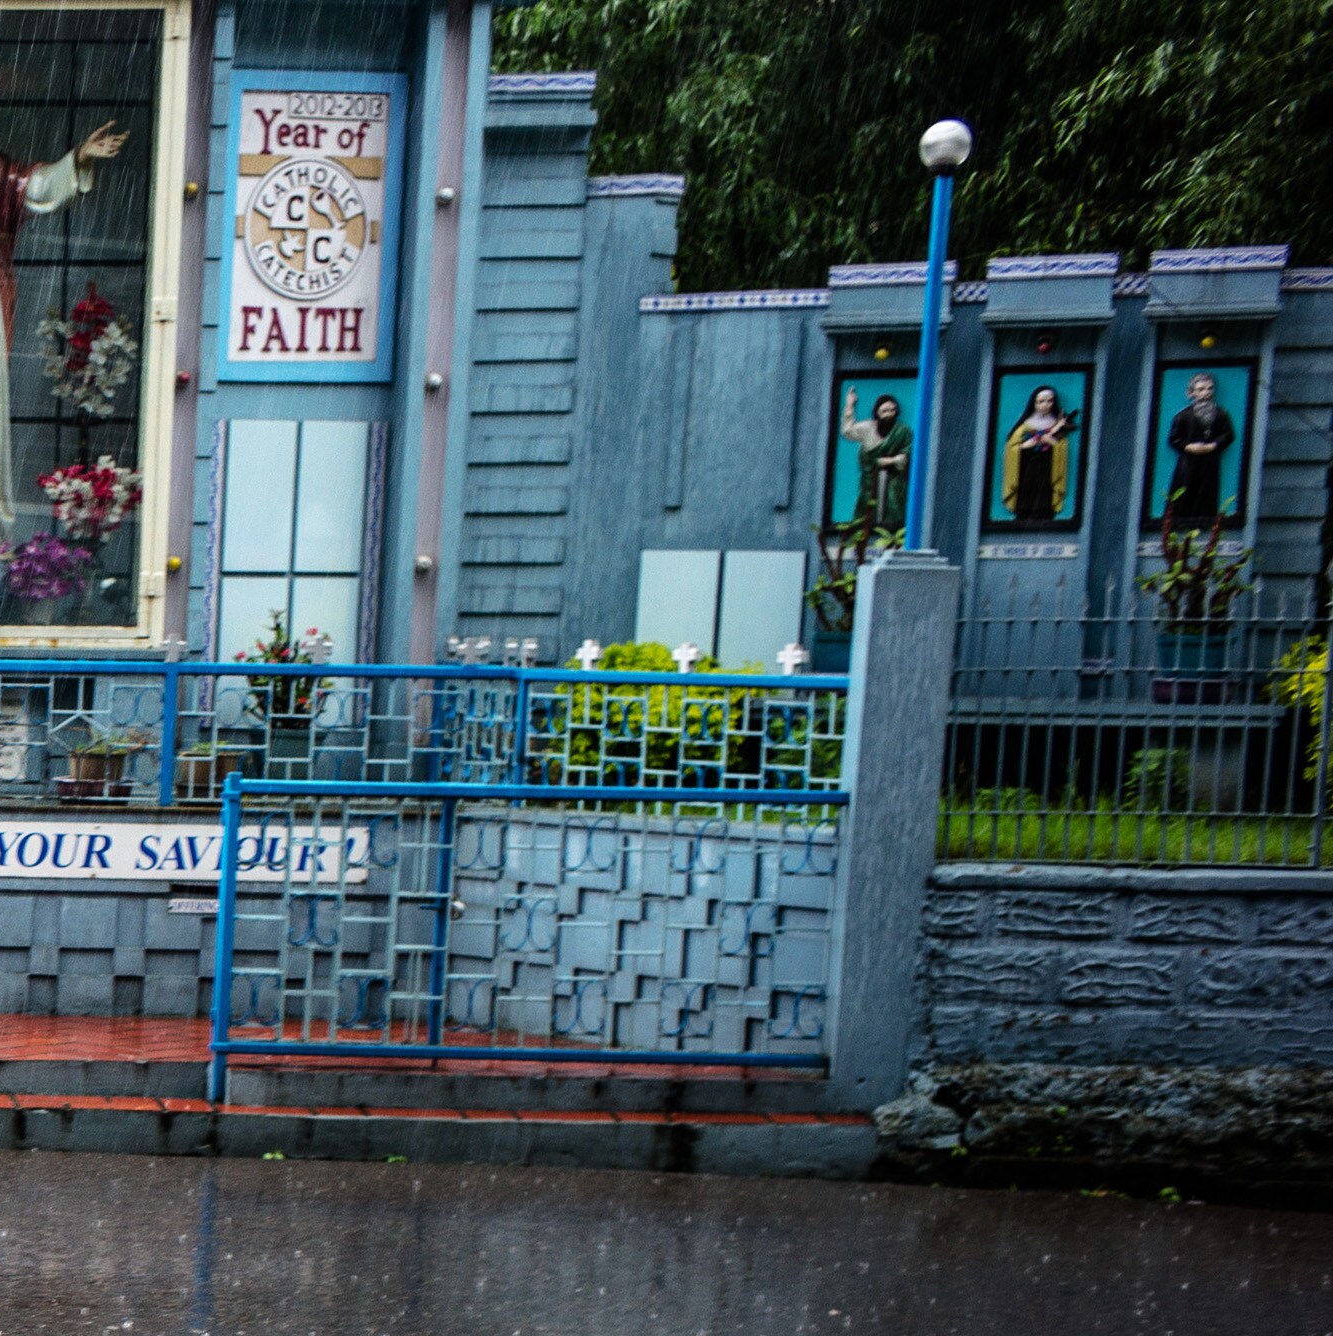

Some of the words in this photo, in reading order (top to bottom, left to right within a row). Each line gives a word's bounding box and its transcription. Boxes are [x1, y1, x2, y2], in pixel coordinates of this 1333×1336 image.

[292, 95, 385, 119] 2012-2013
[254, 109, 328, 155] Year
[337, 122, 370, 157] of
[262, 166, 359, 211] CATHOLIC
[257, 244, 354, 291] CATECHIST
[238, 306, 365, 352] FAITH
[134, 834, 327, 872] SAVIOUR
